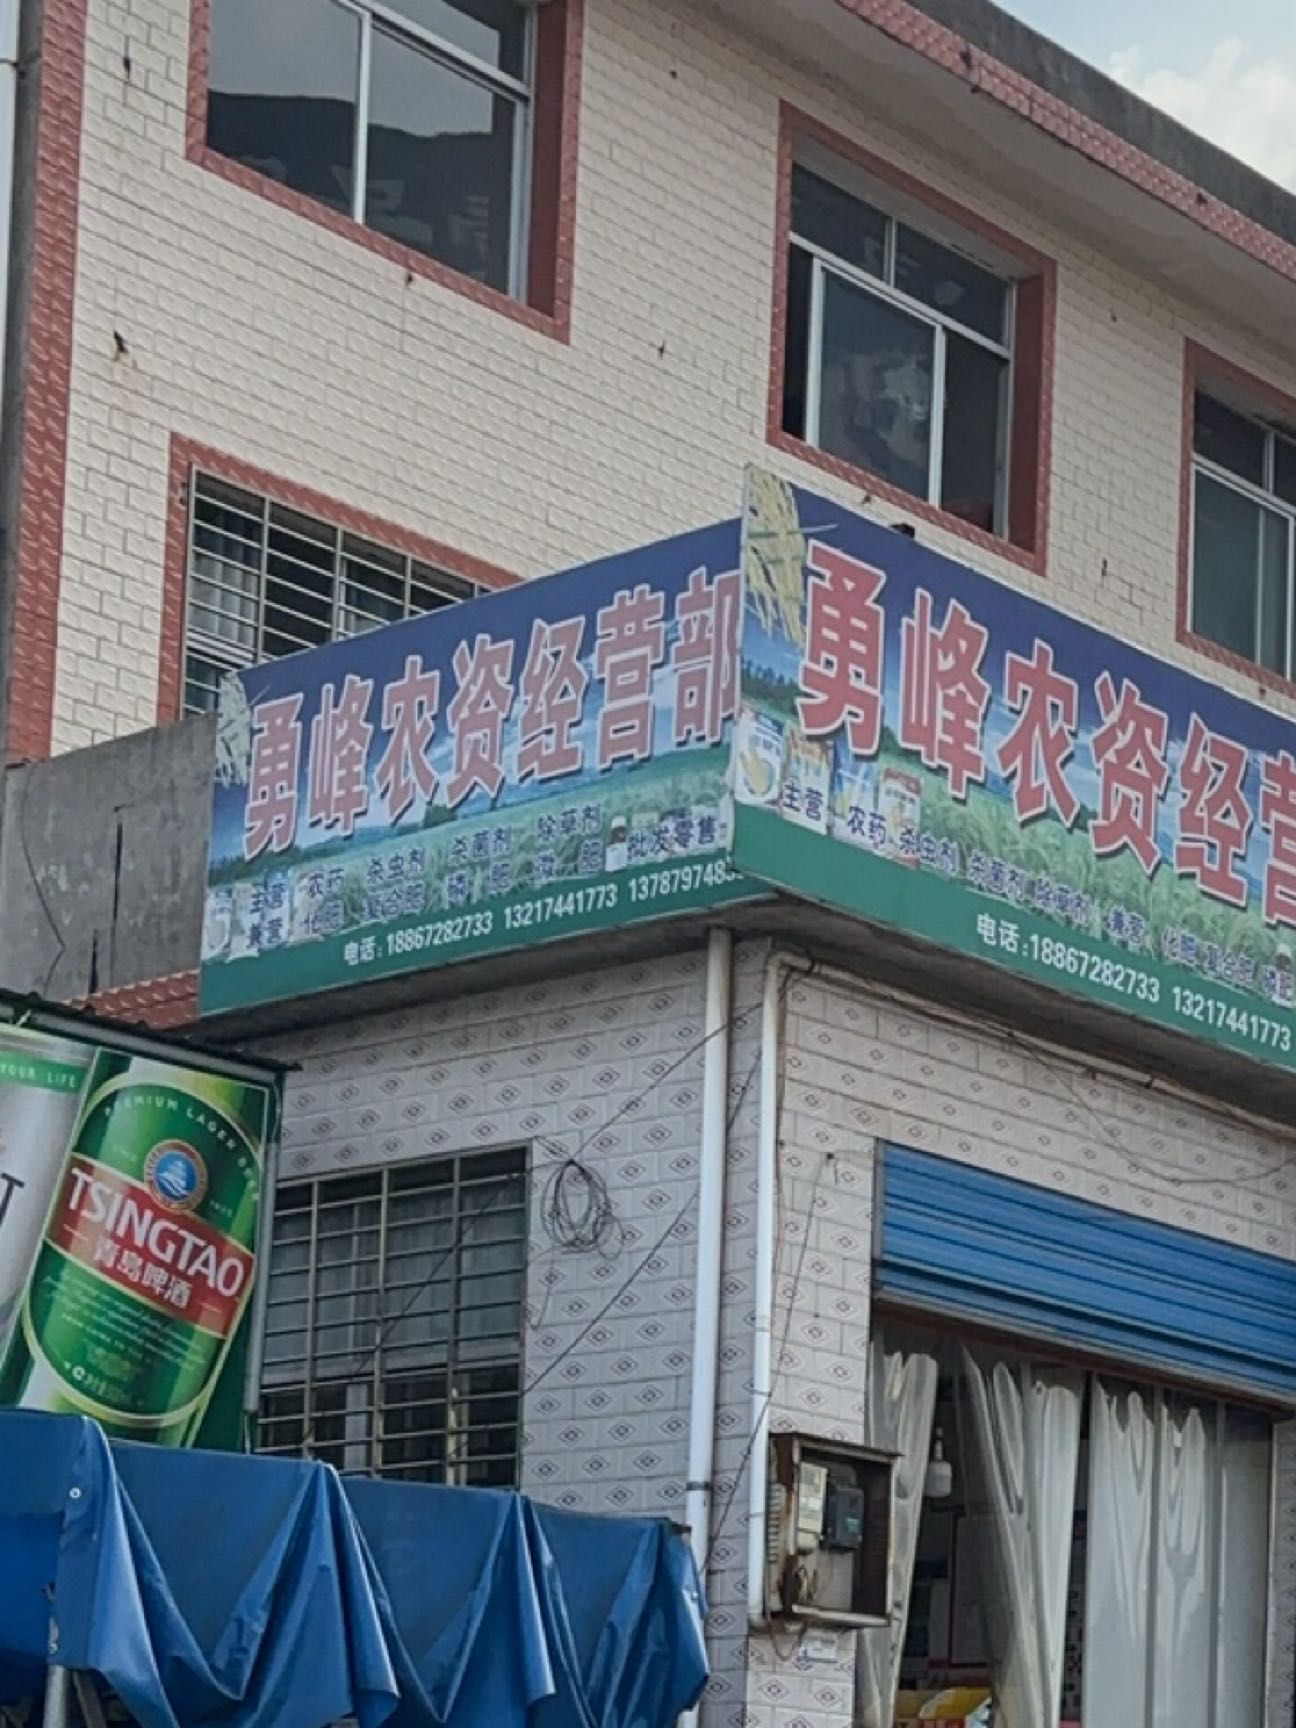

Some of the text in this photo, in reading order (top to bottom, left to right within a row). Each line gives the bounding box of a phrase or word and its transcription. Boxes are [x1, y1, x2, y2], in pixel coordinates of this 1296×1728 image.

[243, 566, 741, 861] 勇峰农资经营部
[784, 784, 823, 820] 主营
[848, 806, 887, 845] 农药
[504, 884, 618, 930] 13217441773
[1172, 986, 1292, 1051] 13217441773
[68, 1167, 245, 1298] TSINGTAO
[93, 1235, 194, 1310] 青岛啤酒
